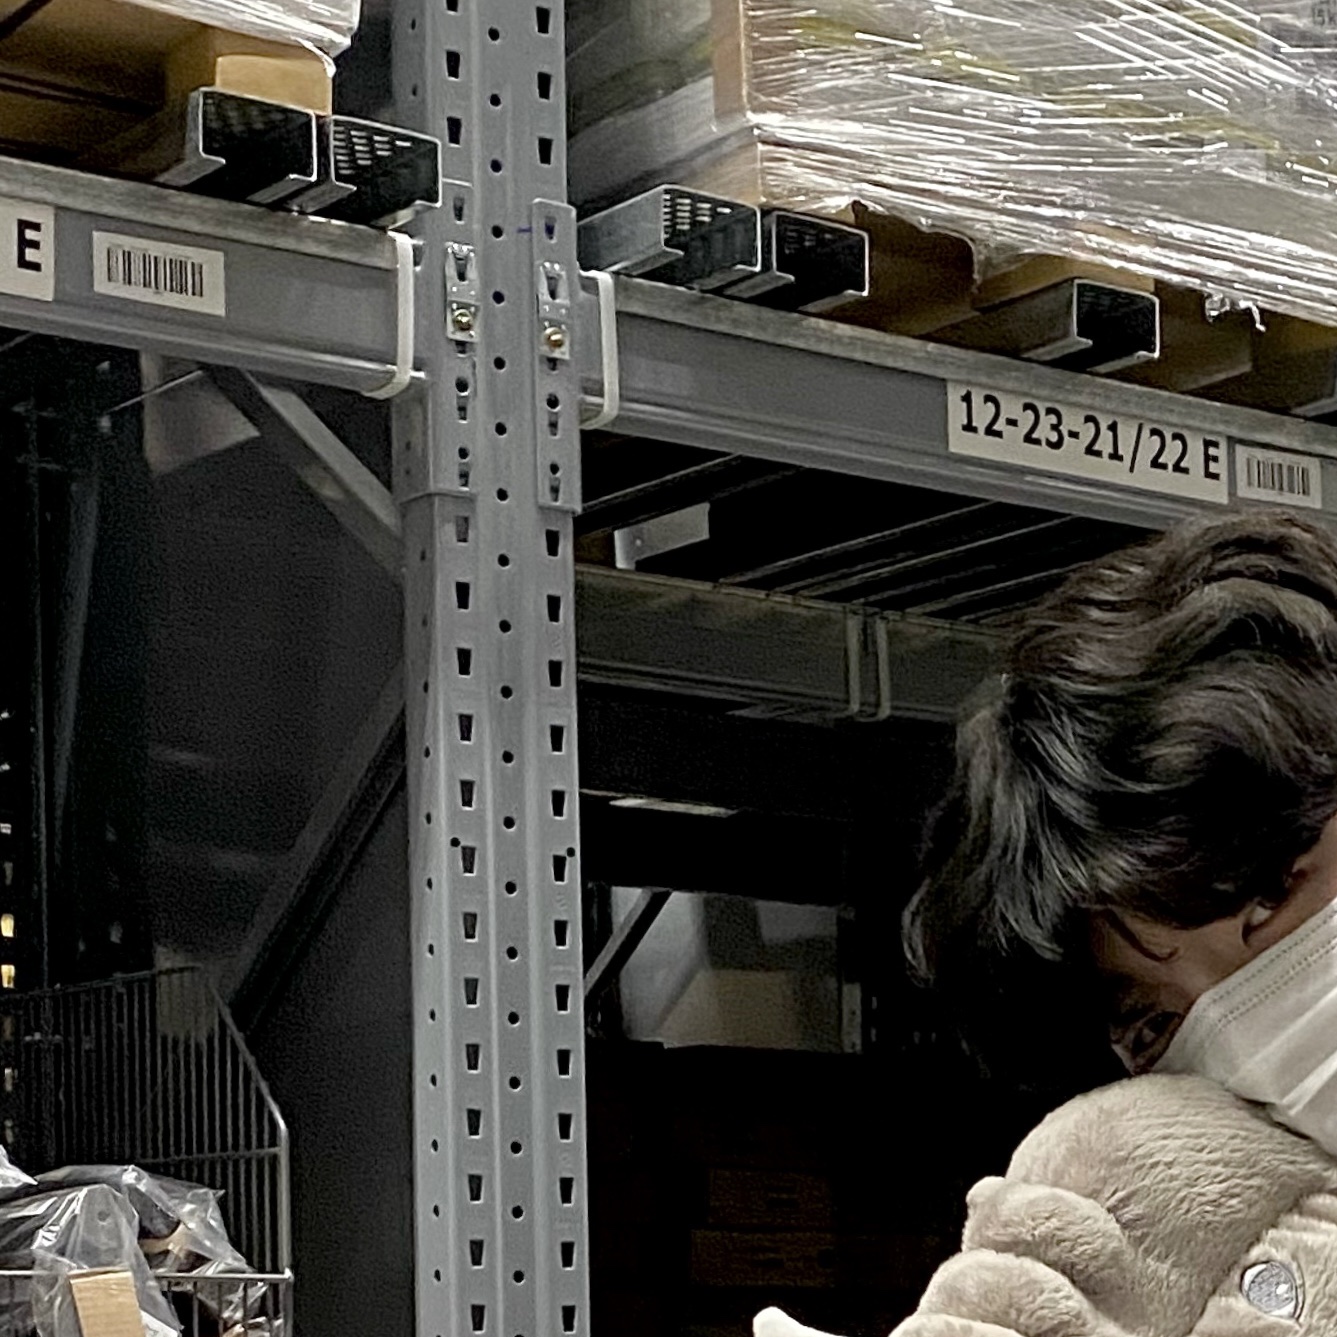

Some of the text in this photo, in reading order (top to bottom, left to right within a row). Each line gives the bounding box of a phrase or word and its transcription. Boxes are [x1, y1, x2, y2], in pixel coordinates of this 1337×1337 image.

[16, 218, 43, 273] E
[961, 389, 1221, 480] 12-23-21/22 E
